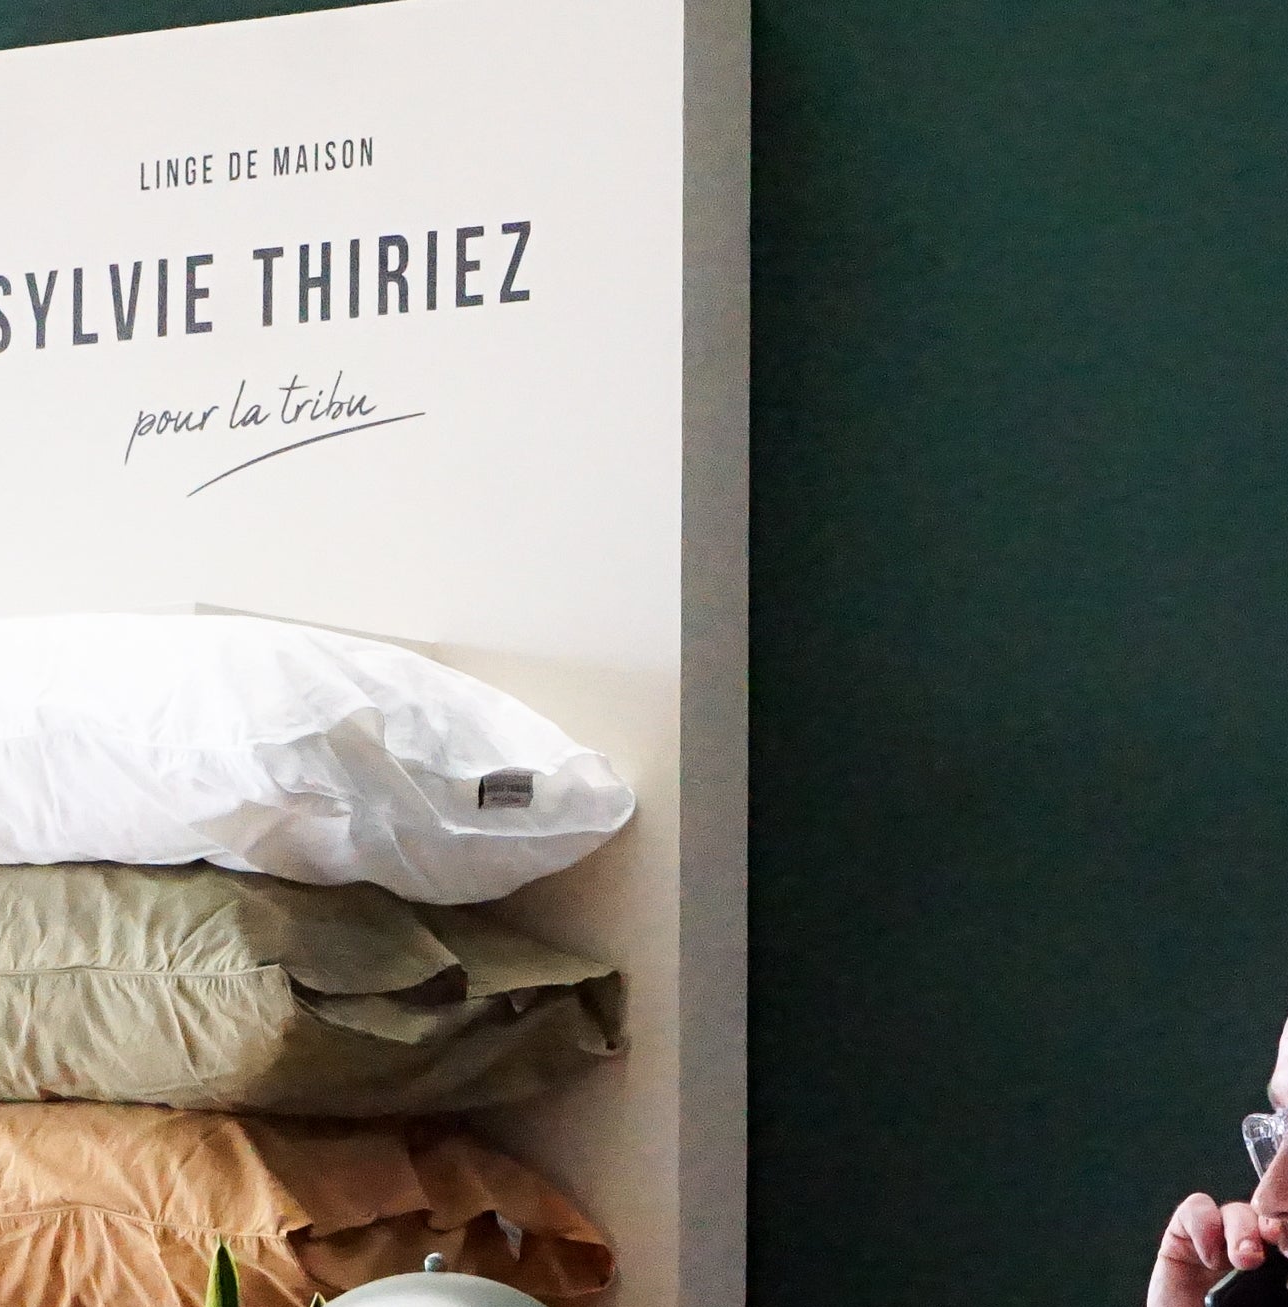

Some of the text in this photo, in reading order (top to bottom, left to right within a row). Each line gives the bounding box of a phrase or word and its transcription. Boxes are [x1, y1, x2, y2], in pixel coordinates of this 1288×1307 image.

[140, 136, 373, 191] LINGE DE MAISON
[252, 220, 532, 327] THIRIEZ
[125, 370, 378, 463] pour la tribu
